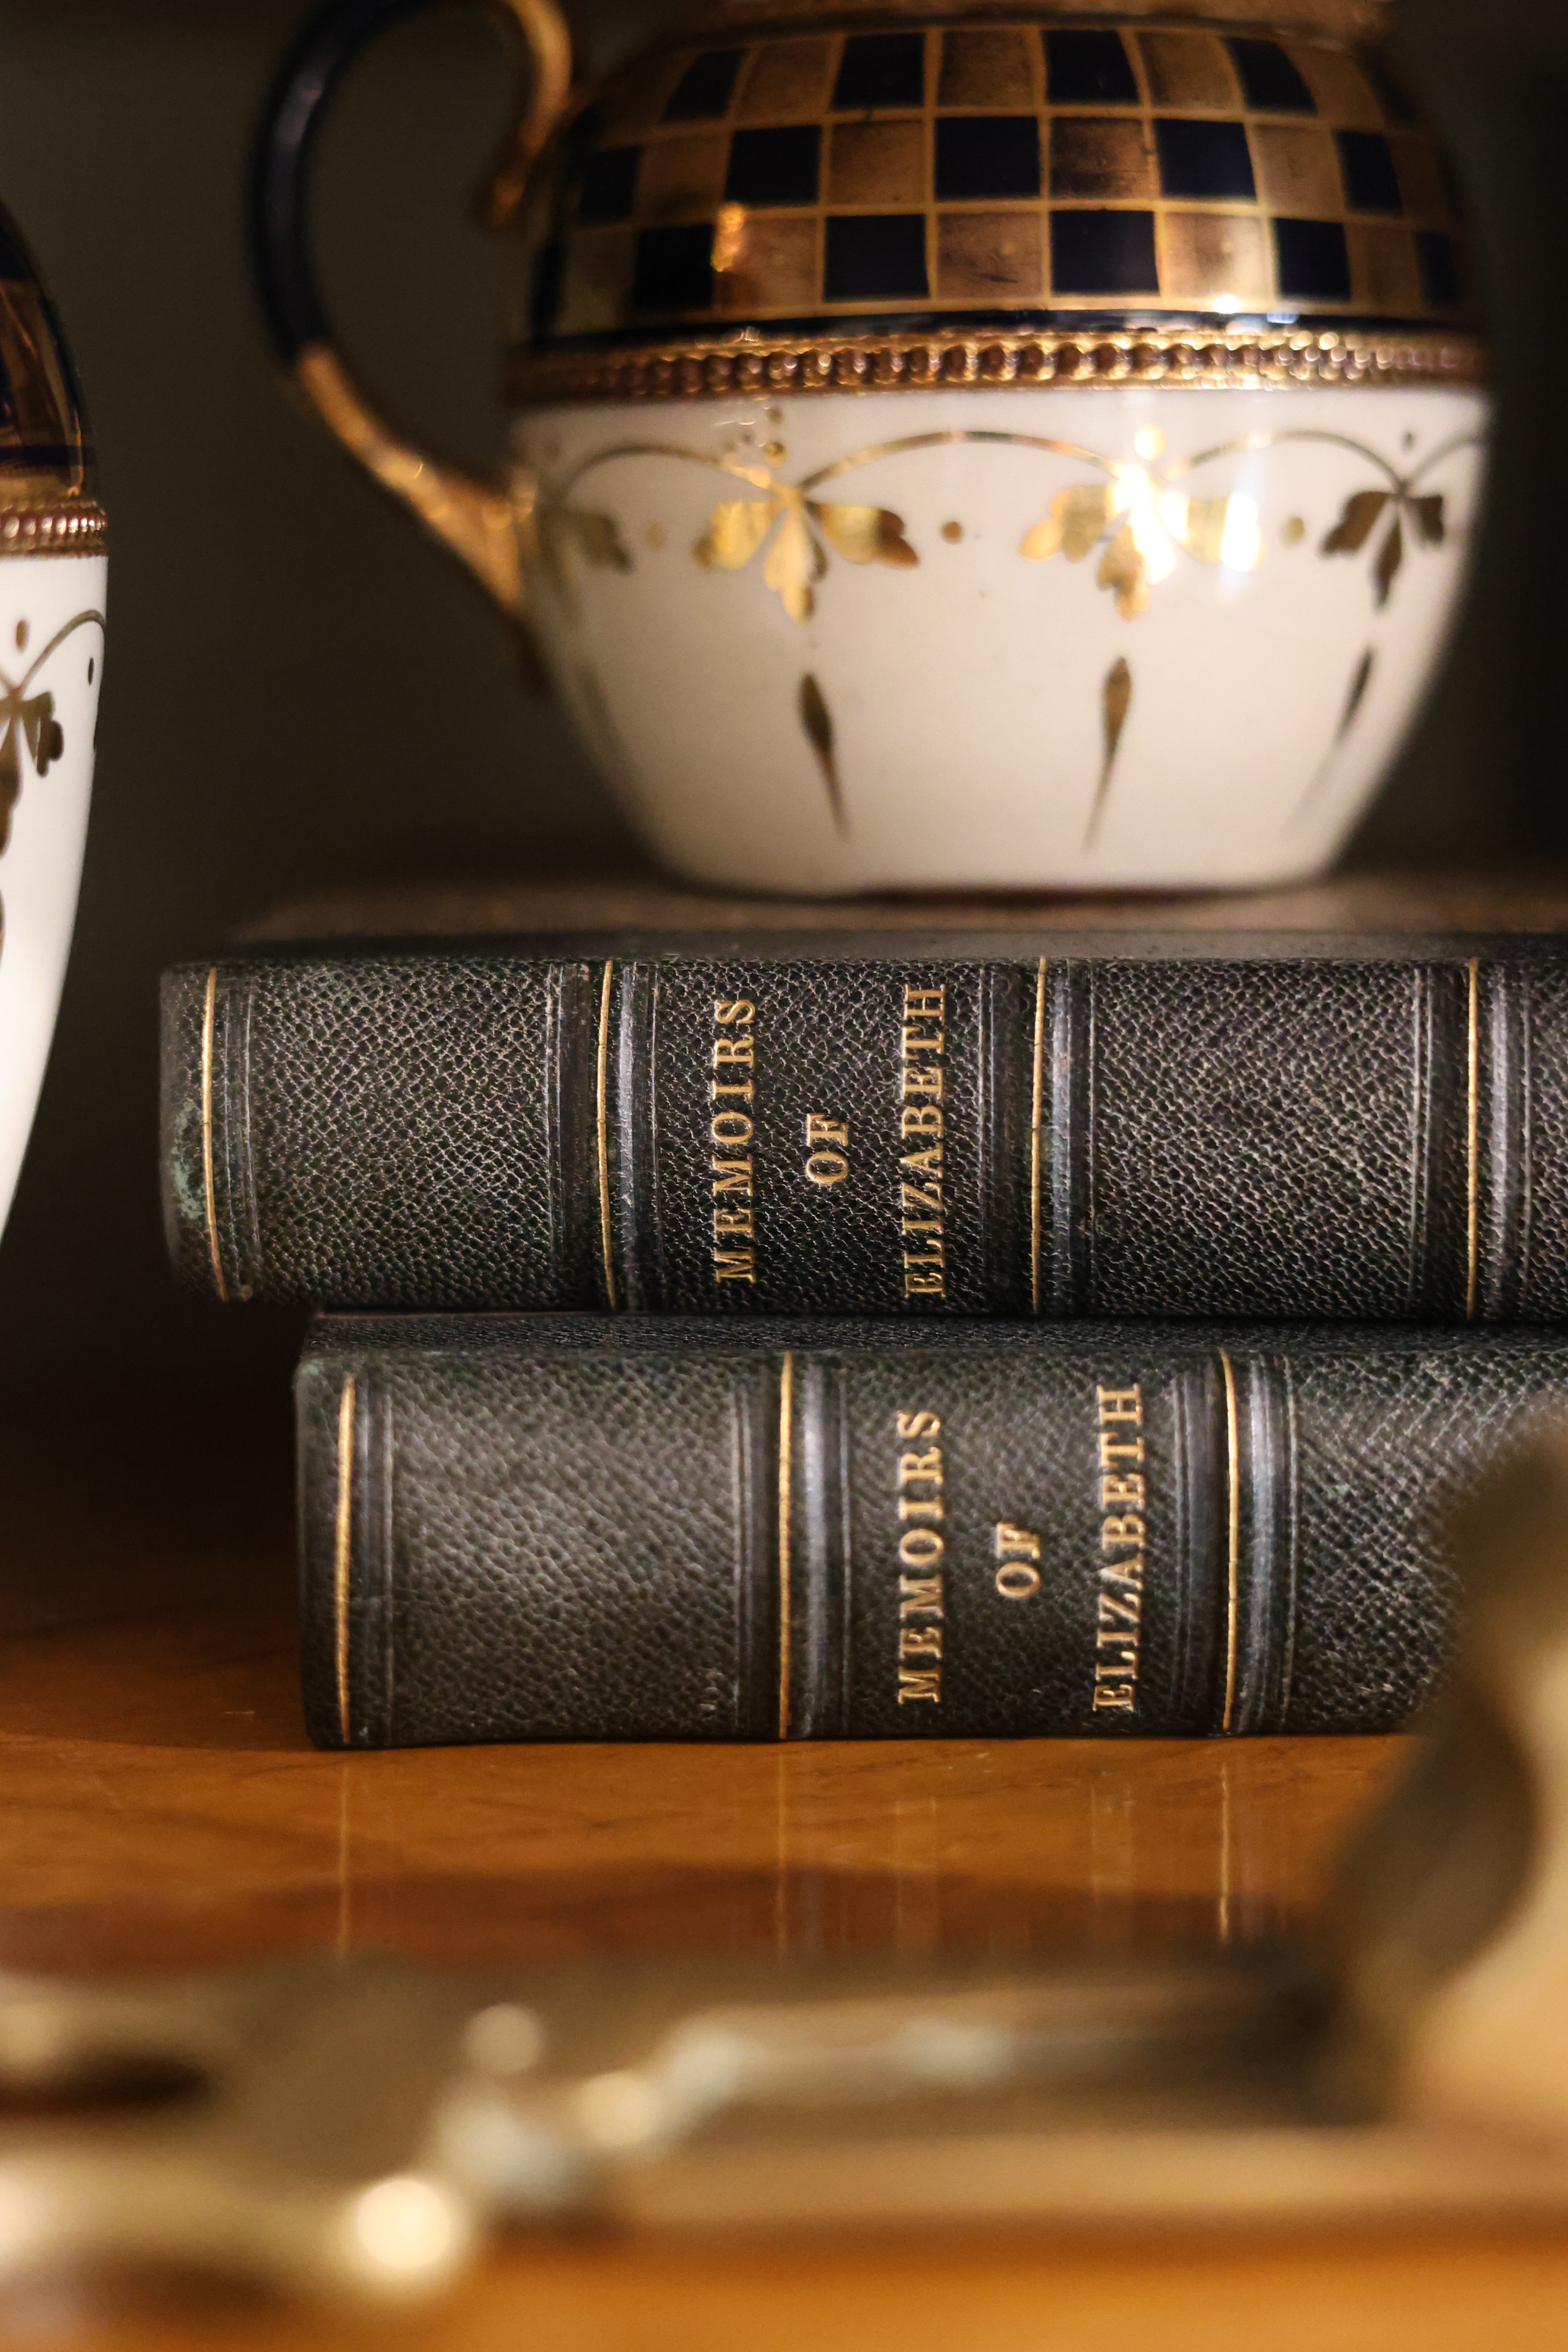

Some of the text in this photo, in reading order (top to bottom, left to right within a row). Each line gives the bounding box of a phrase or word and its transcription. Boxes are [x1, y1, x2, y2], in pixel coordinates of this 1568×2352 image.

[711, 998, 756, 1284] MEMOIRS
[806, 1112, 849, 1185] OF
[900, 983, 946, 1299] ELIZABETH
[896, 1409, 945, 1705] MEMOIRS
[995, 1521, 1042, 1600] OF
[1092, 1383, 1146, 1712] ELIZABETH
